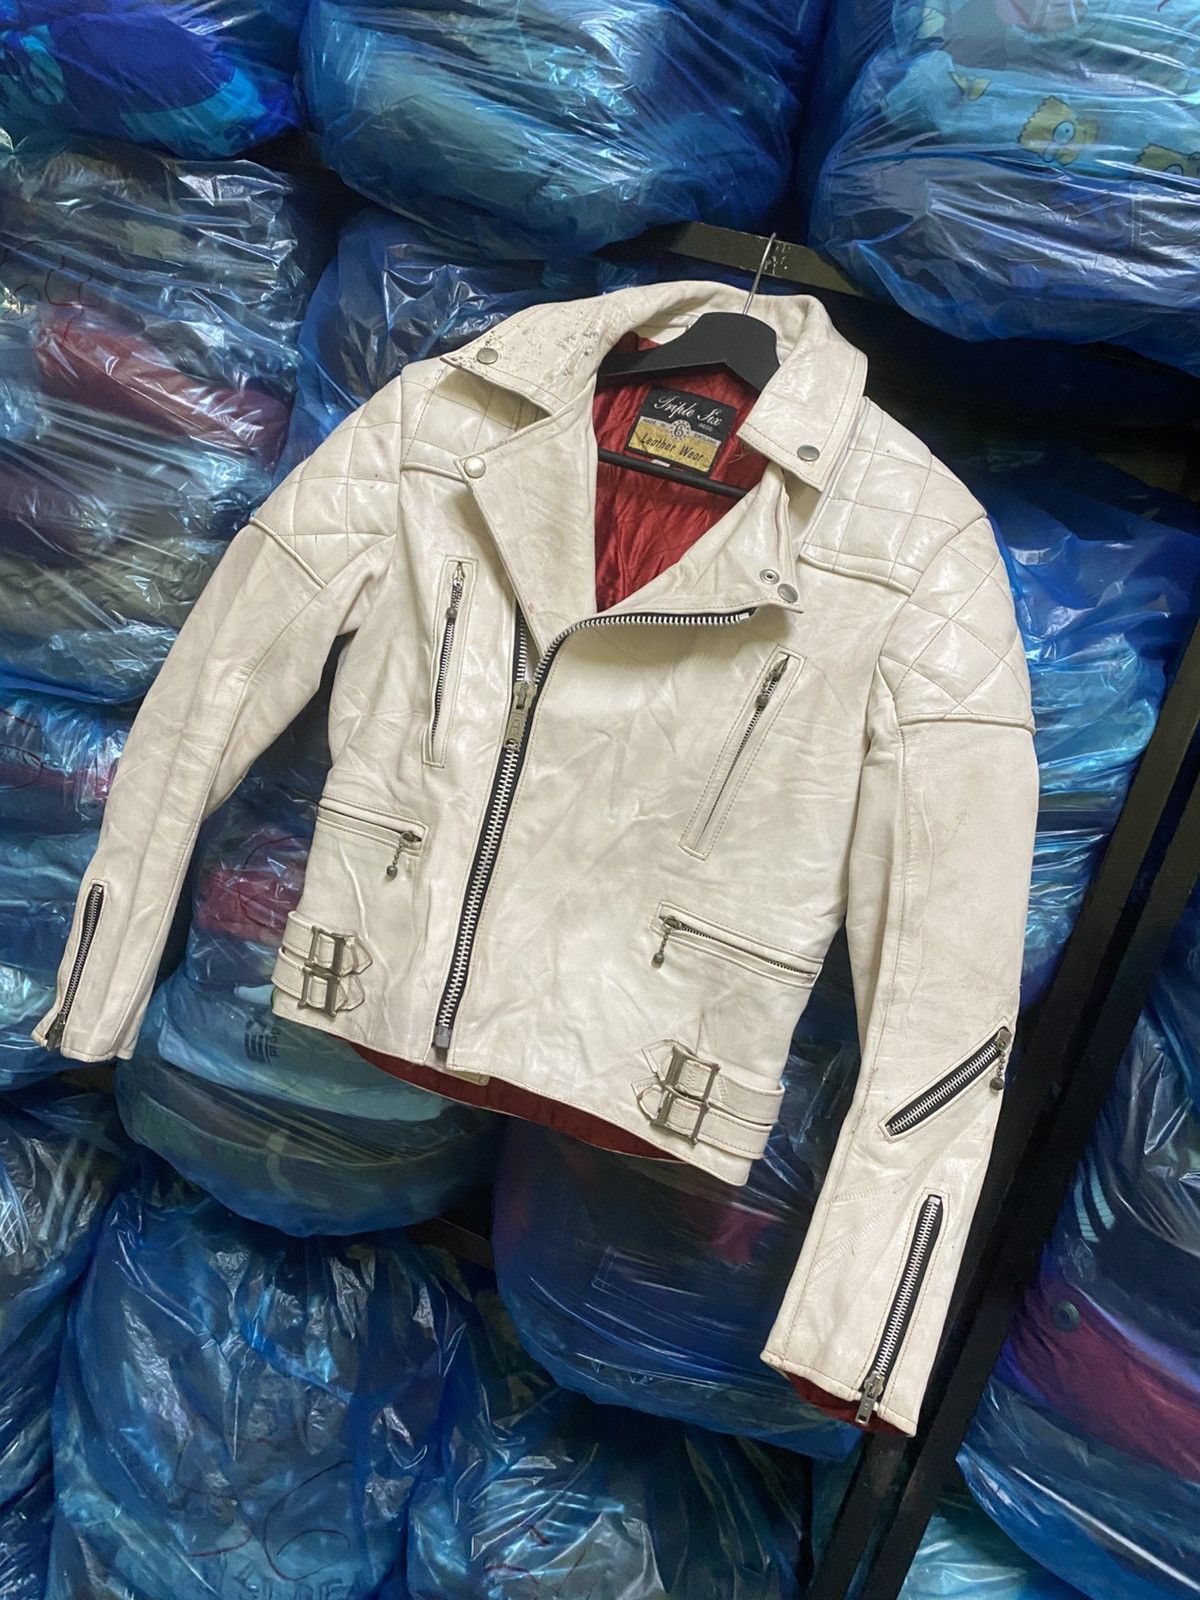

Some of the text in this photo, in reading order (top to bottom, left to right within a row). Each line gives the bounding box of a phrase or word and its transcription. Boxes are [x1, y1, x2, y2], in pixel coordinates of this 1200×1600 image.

[653, 396, 723, 426] Triple Six
[641, 433, 705, 461] Leather Wear
